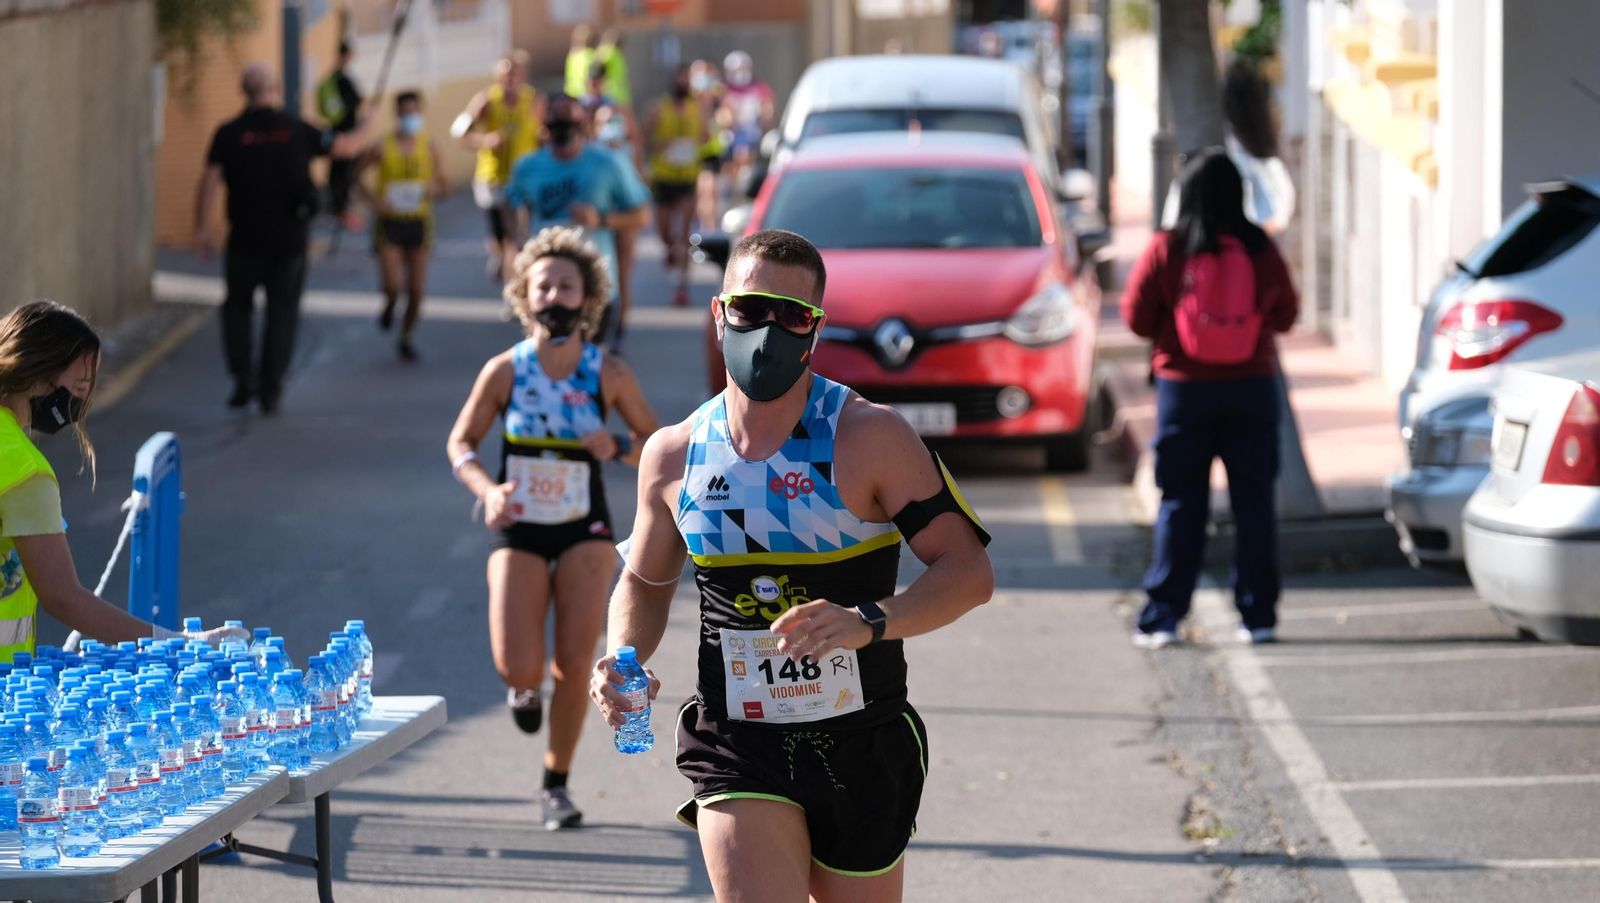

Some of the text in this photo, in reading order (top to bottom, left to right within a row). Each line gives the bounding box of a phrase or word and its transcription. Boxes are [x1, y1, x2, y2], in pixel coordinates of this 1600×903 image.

[527, 476, 566, 497] 209
[769, 471, 815, 500] ego
[706, 493, 730, 501] mobel
[733, 663, 745, 674] SN
[758, 654, 822, 685] 148
[829, 655, 848, 676] R
[769, 681, 823, 699] VIDOMINE
